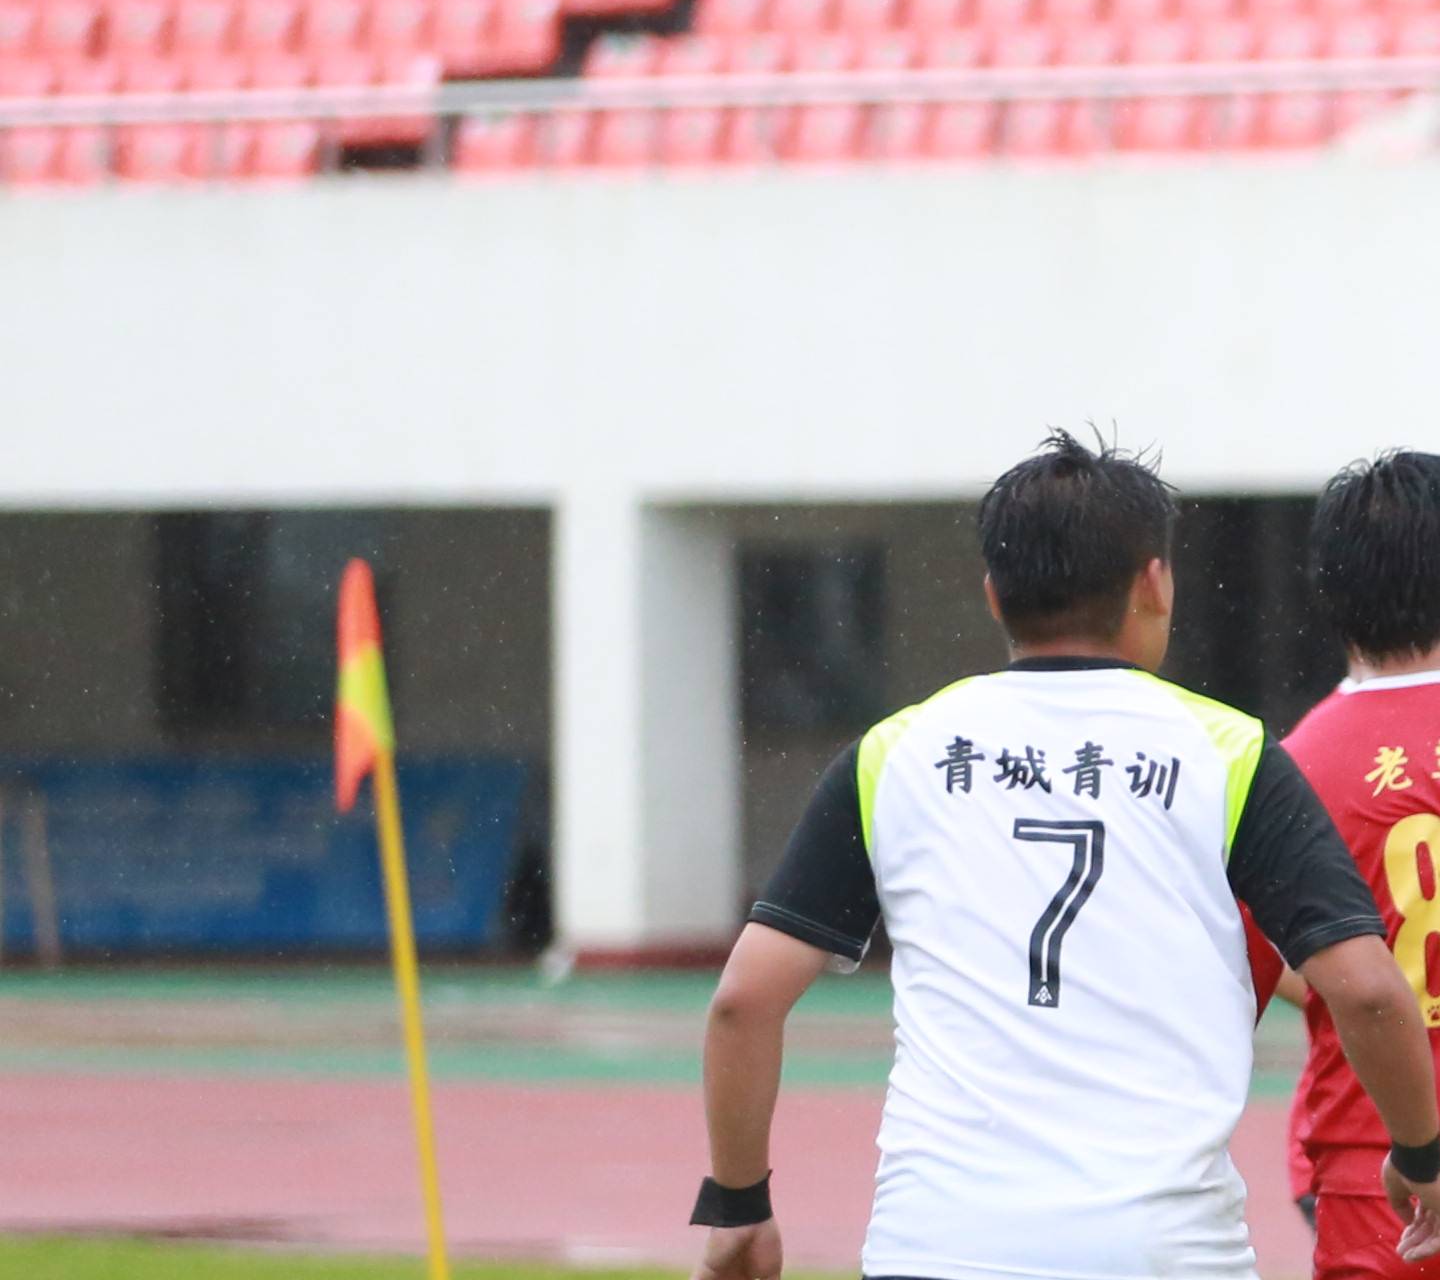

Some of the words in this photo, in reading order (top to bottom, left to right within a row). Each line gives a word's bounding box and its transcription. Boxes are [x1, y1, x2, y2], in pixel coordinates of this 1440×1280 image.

[934, 734, 1182, 811] 青城青训
[1012, 818, 1106, 1008] 7
